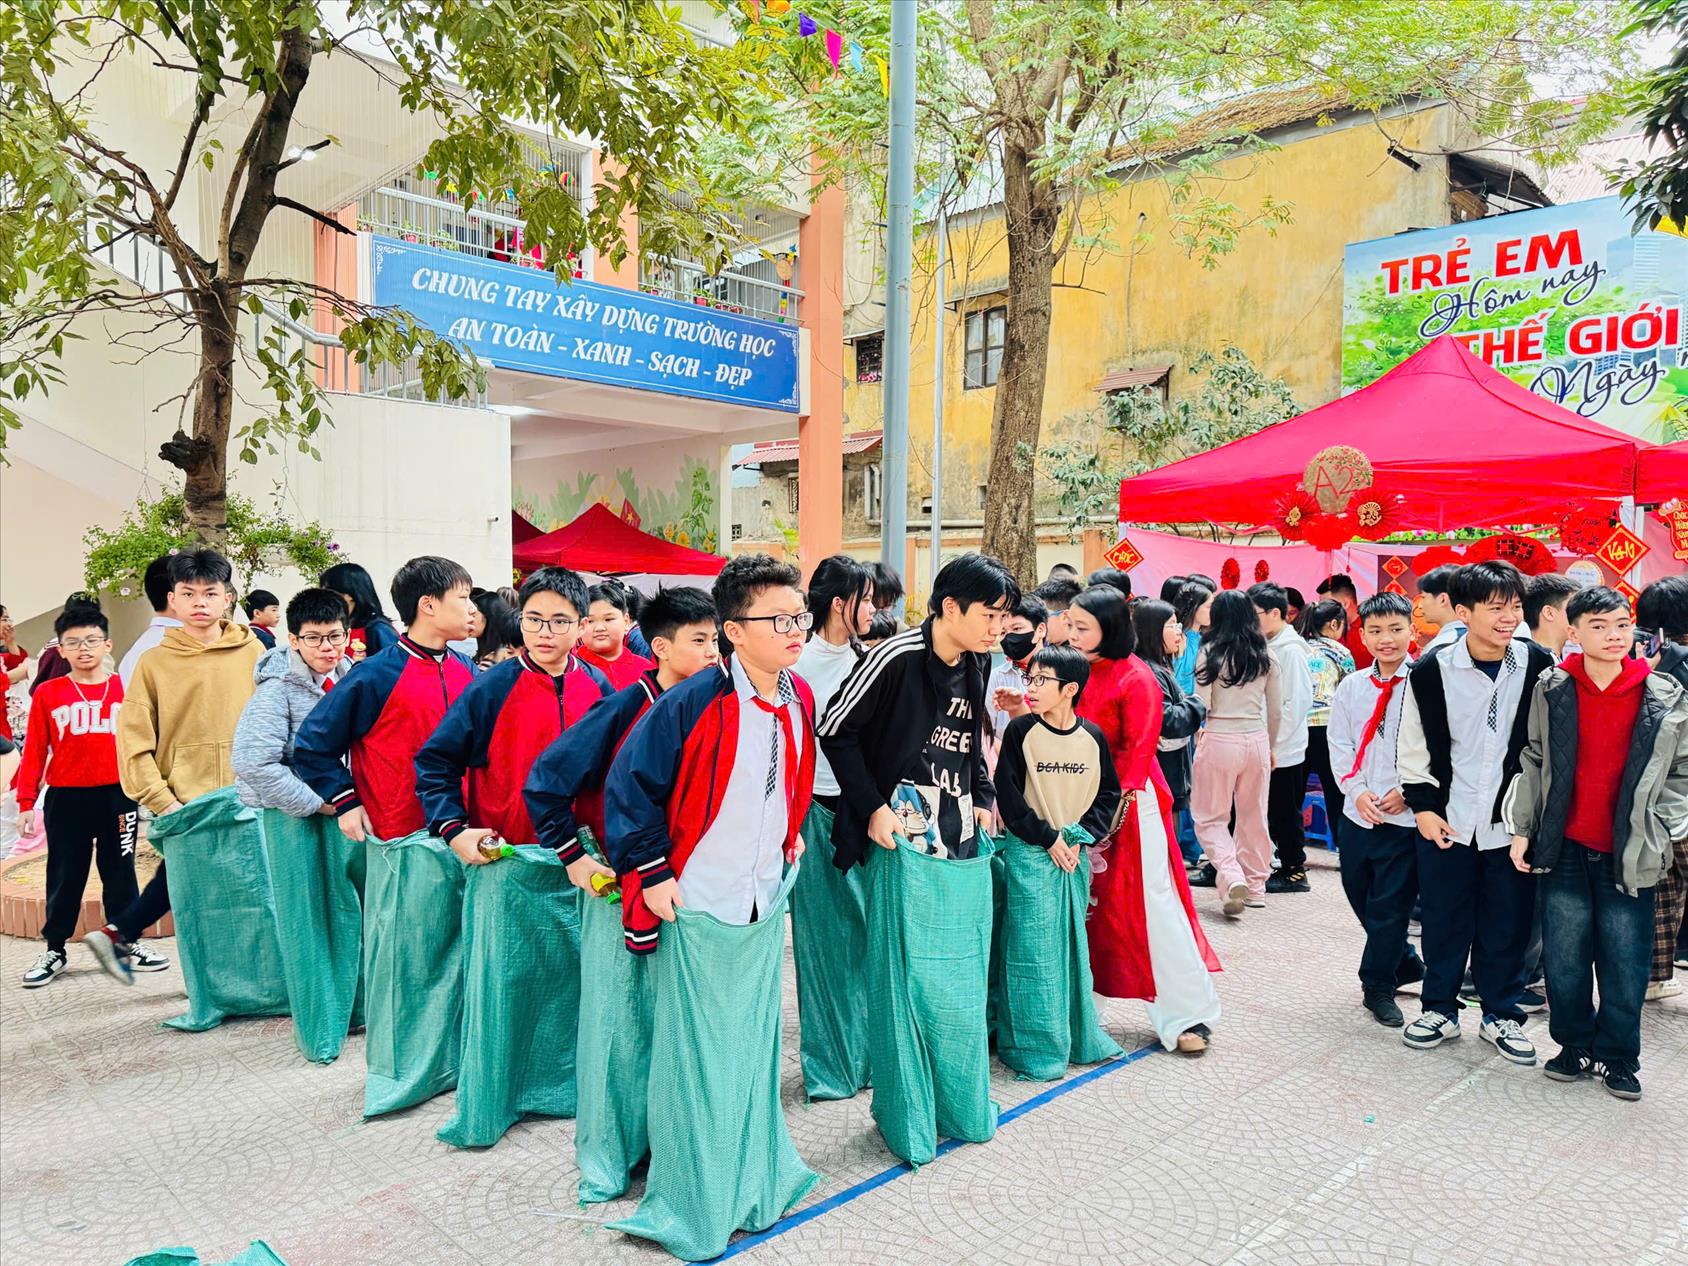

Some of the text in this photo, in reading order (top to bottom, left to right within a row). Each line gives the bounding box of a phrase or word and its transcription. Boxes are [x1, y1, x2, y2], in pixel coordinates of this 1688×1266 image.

[1381, 228, 1583, 294] TRẺ EM
[412, 267, 776, 359] CHUNG TAY XÂY DỰNG TRƯỜNG HỌC
[1420, 260, 1606, 338] Hôm nay
[449, 317, 486, 342] AN
[491, 322, 555, 353] TOÀN
[572, 337, 632, 366] XANH
[648, 351, 701, 378] SẠCH
[715, 364, 752, 390] ĐẸP
[1569, 302, 1679, 355] GIỚI
[1530, 360, 1666, 417] Ngày
[1314, 465, 1363, 499] A2
[930, 725, 972, 752] GREE
[120, 811, 137, 857] DUNK
